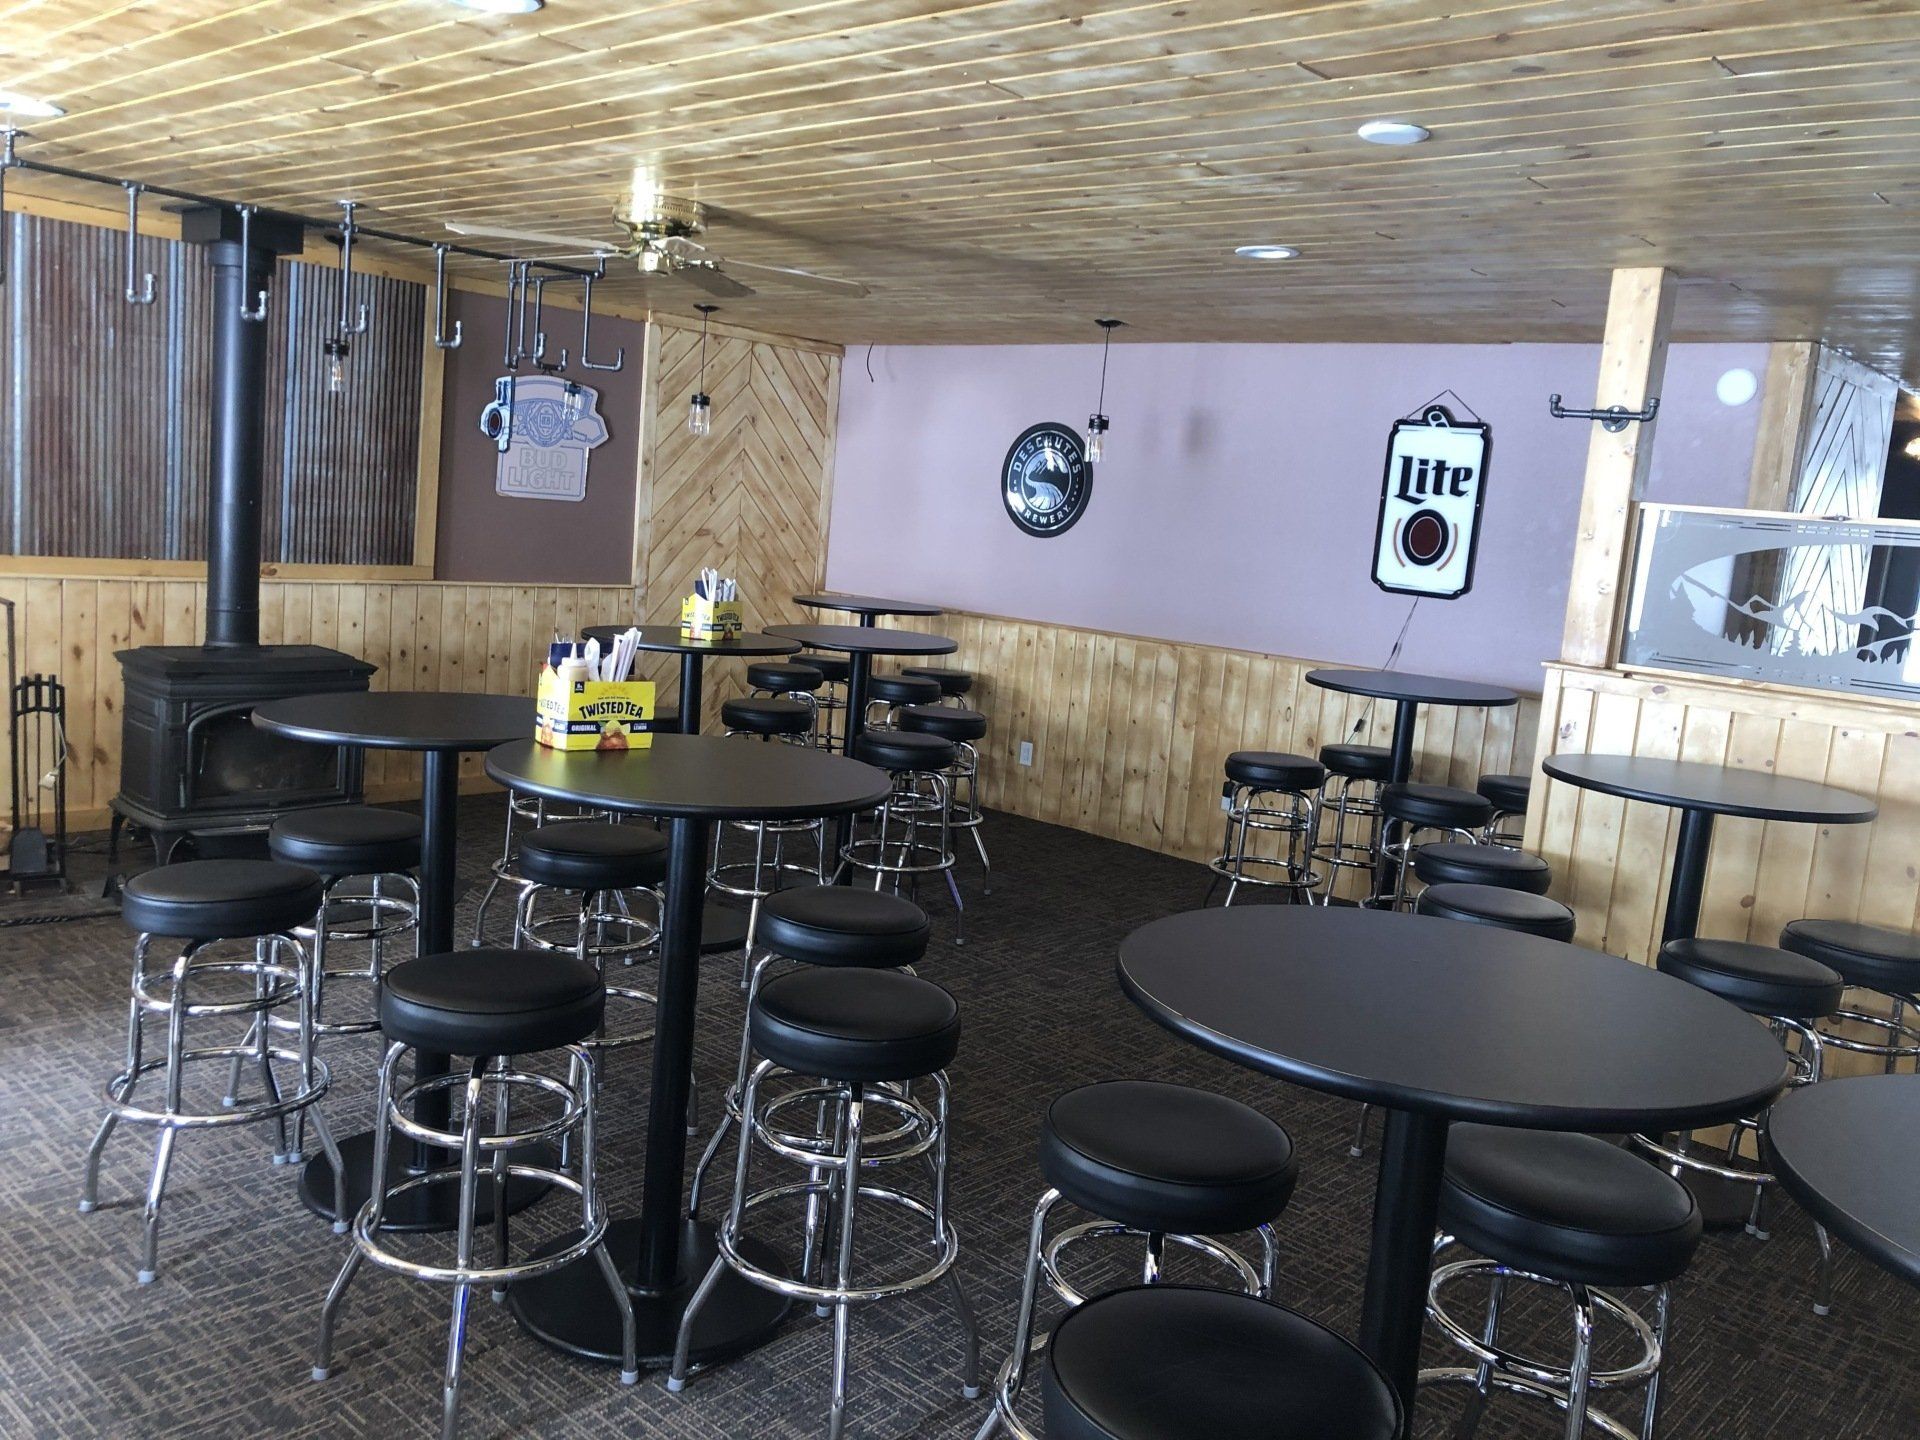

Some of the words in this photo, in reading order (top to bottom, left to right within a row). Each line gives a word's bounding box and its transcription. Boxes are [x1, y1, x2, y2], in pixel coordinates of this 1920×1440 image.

[520, 447, 568, 469] BUD
[1013, 435, 1081, 474] DESCHUTES
[507, 466, 574, 490] LIGHT
[1394, 455, 1474, 505] Lite
[1017, 503, 1071, 524] REWERY
[579, 702, 624, 719] TWISTED
[624, 702, 644, 718] TEA
